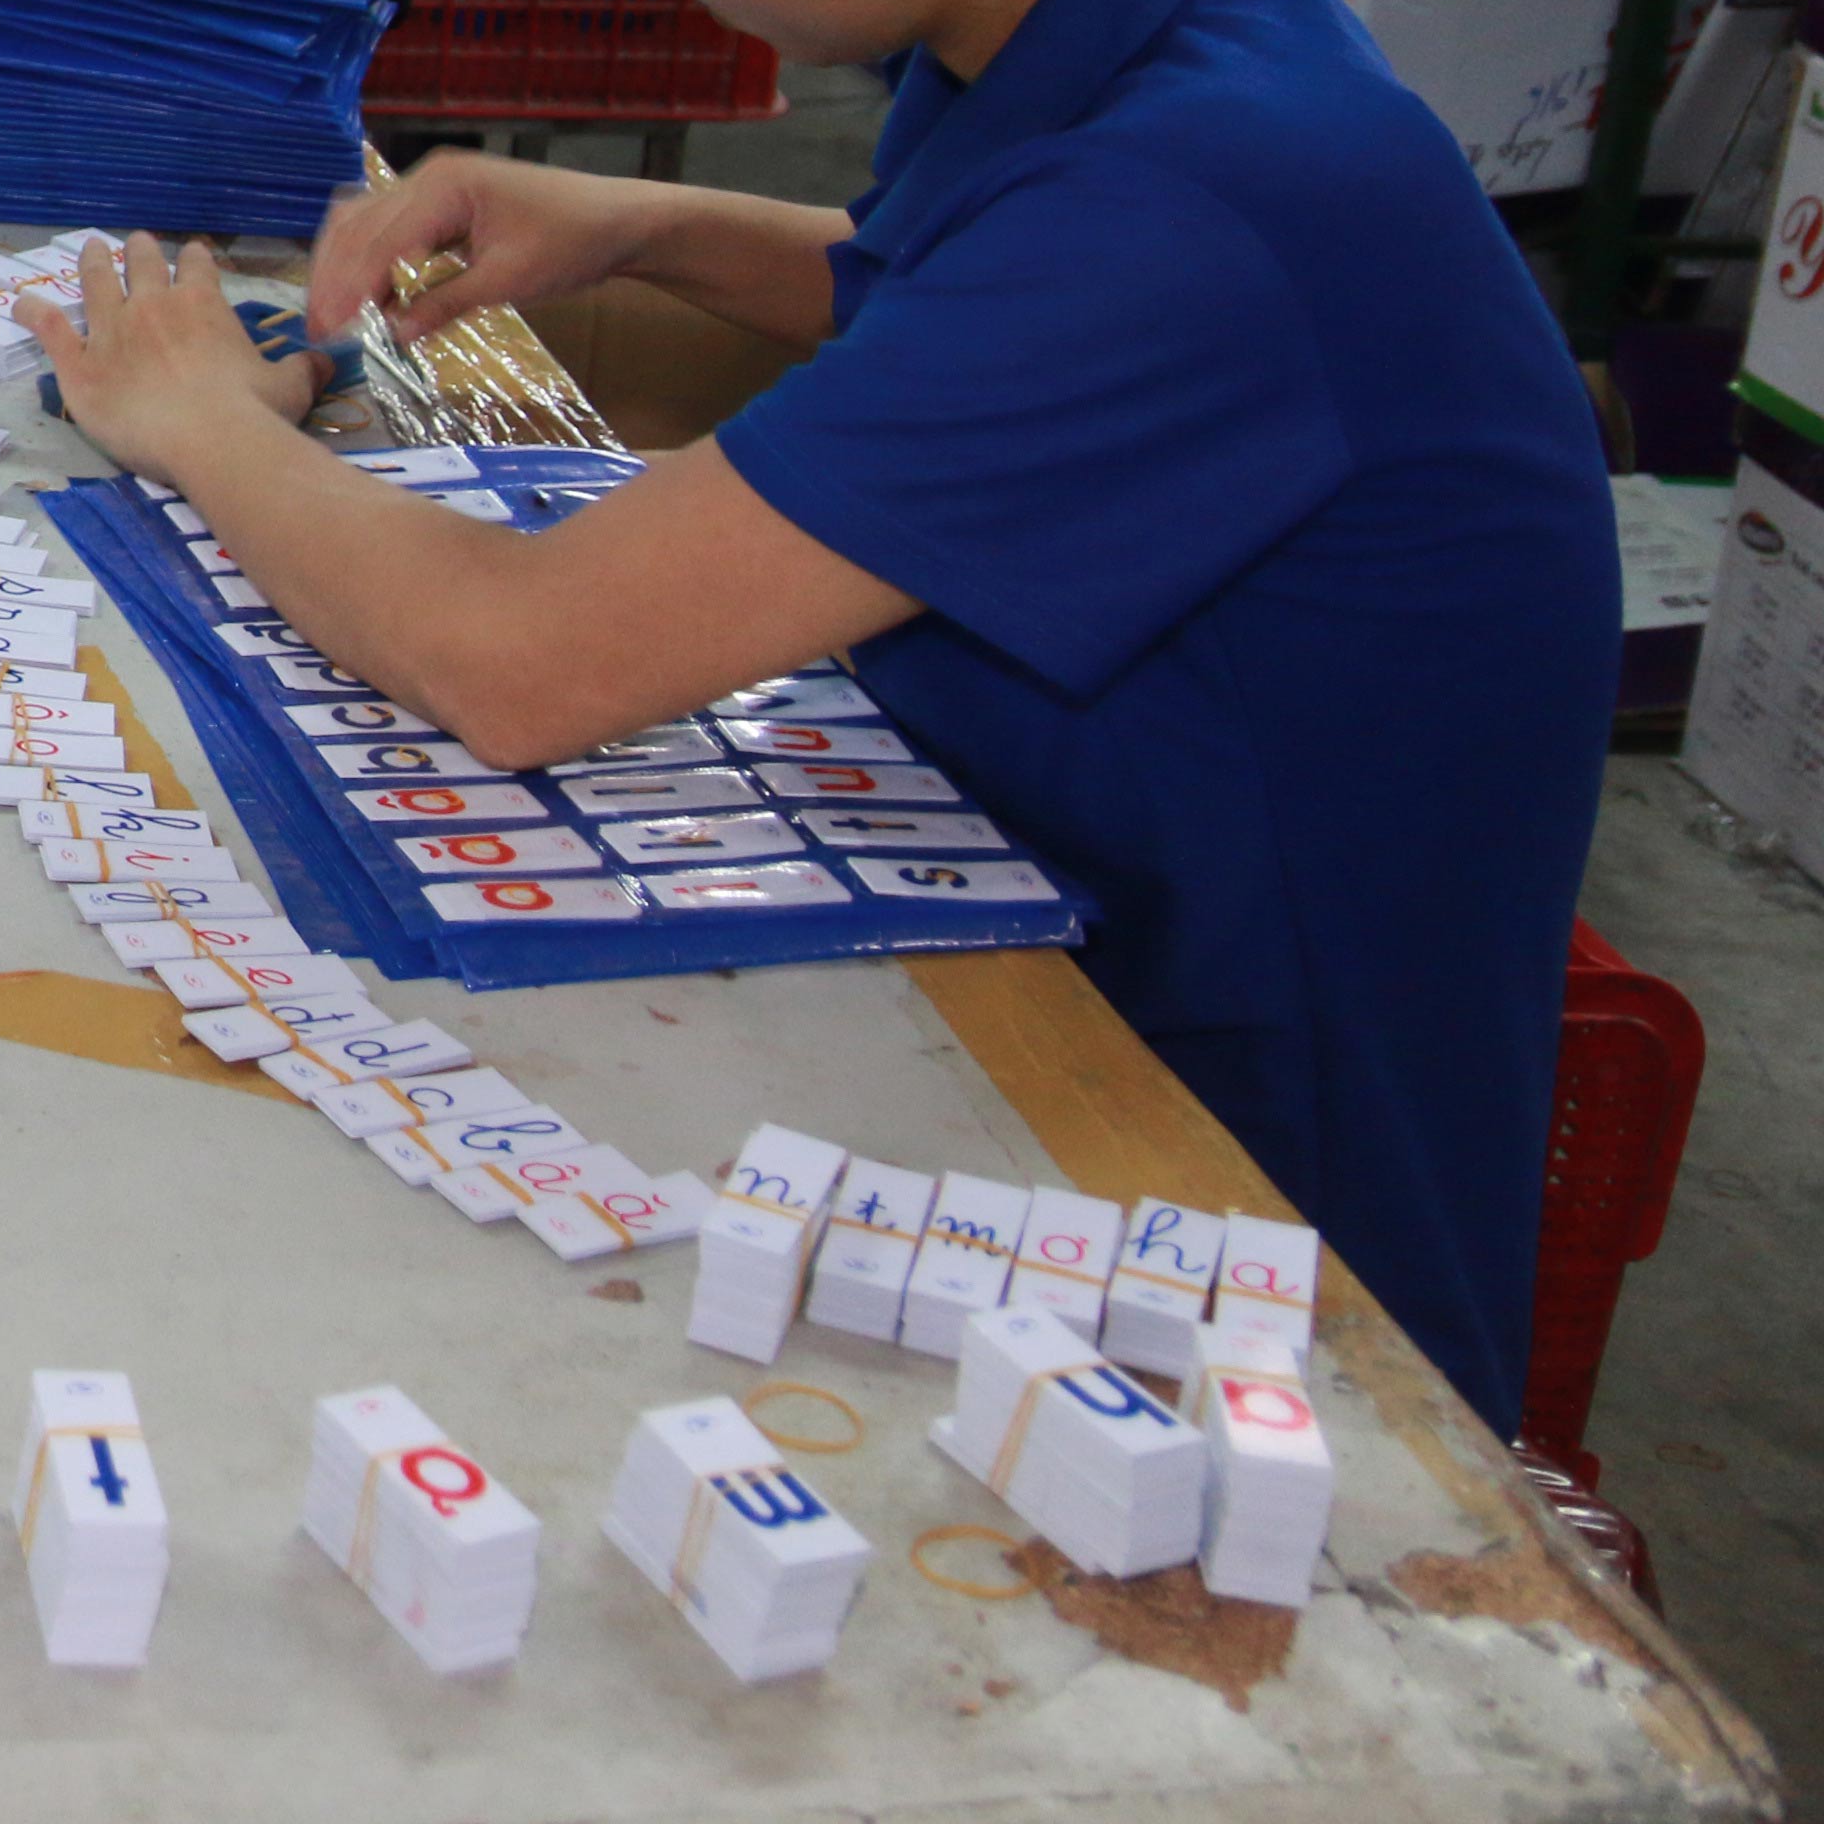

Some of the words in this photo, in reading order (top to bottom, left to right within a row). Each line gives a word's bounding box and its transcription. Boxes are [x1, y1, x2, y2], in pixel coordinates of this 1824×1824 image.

[14, 704, 69, 721] ô
[332, 704, 396, 729] c
[16, 739, 58, 756] o
[358, 746, 439, 773] b
[377, 789, 466, 815] â
[830, 817, 917, 831] t
[419, 834, 516, 865] ă
[898, 866, 968, 889] s
[475, 881, 553, 911] a
[344, 1039, 428, 1069] d
[407, 1086, 453, 1109] c
[460, 1121, 562, 1153] b
[735, 1166, 807, 1207] n
[855, 1191, 896, 1231] t
[936, 1210, 1010, 1259] m
[1127, 1206, 1207, 1275] h
[1231, 1261, 1300, 1295] a
[87, 1436, 127, 1506] t
